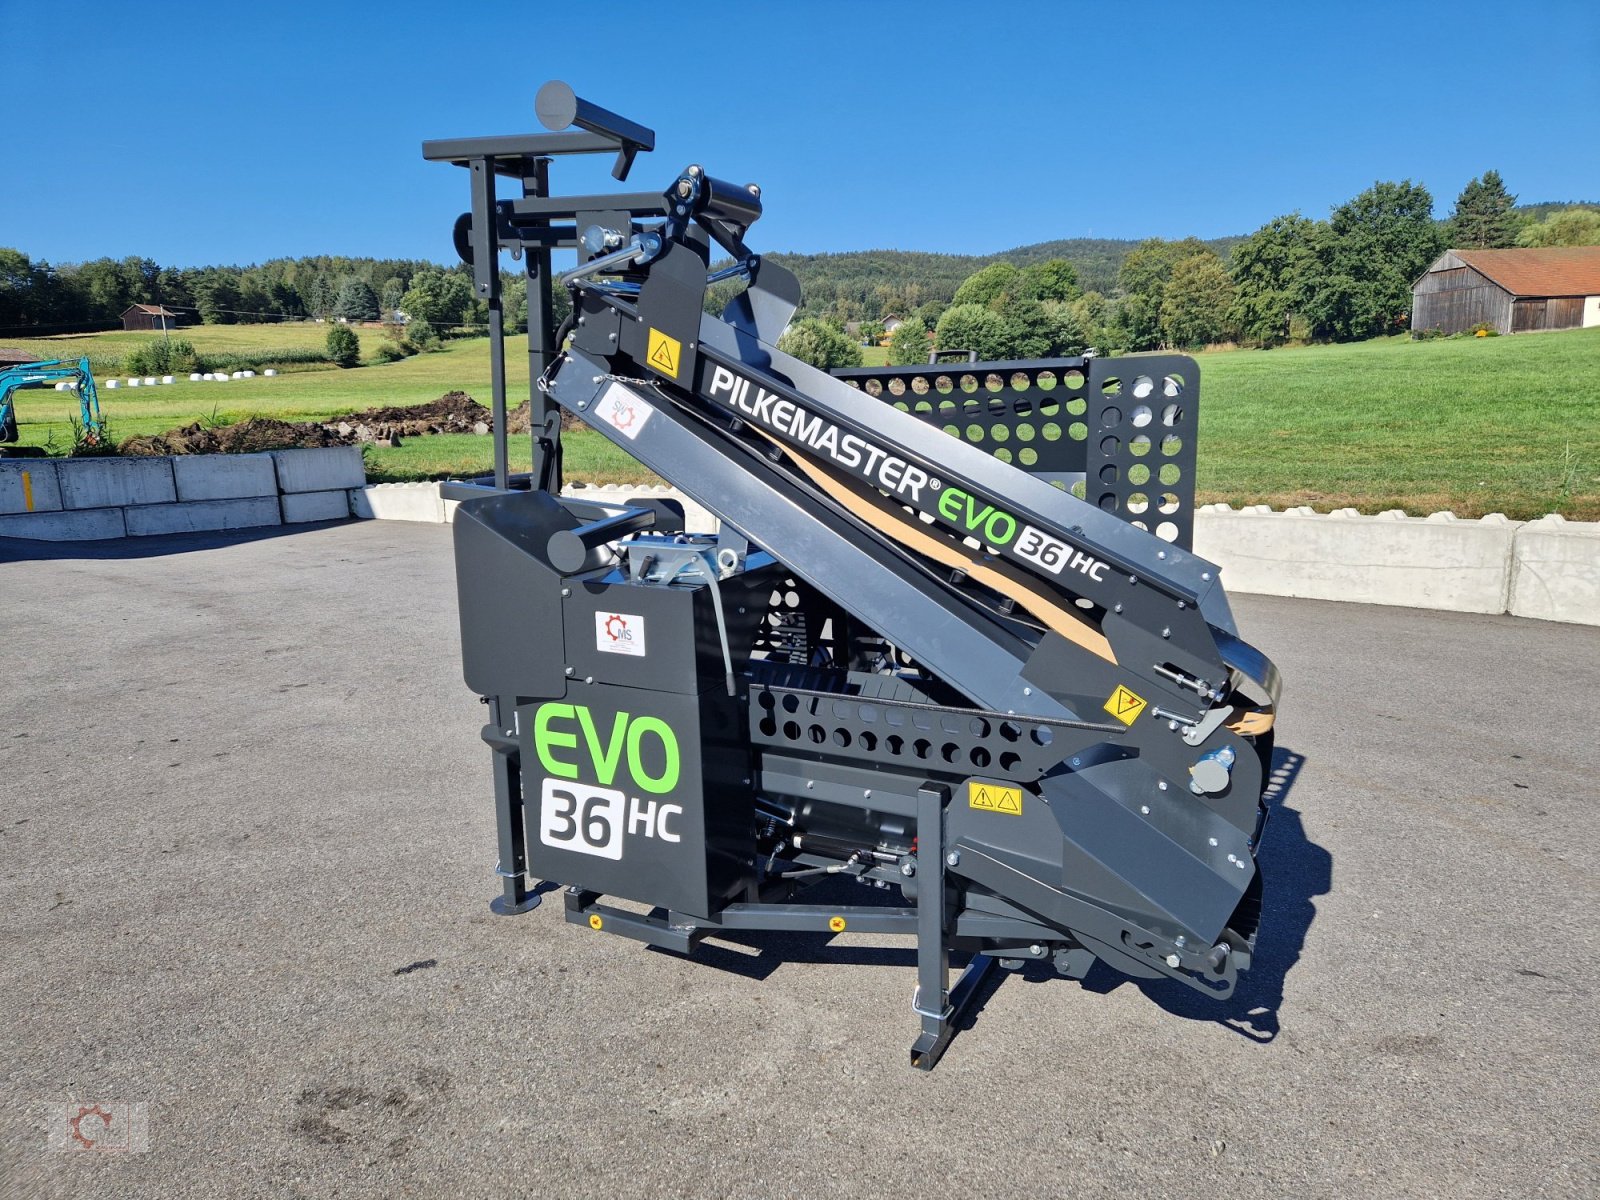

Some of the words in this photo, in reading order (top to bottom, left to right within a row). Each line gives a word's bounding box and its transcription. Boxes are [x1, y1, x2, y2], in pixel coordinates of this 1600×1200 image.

[938, 487, 1017, 545] EVO
[1019, 531, 1064, 566] 36
[1069, 551, 1110, 582] HC
[534, 702, 681, 794] EVO
[548, 788, 612, 849] 36
[627, 797, 683, 843] HC
